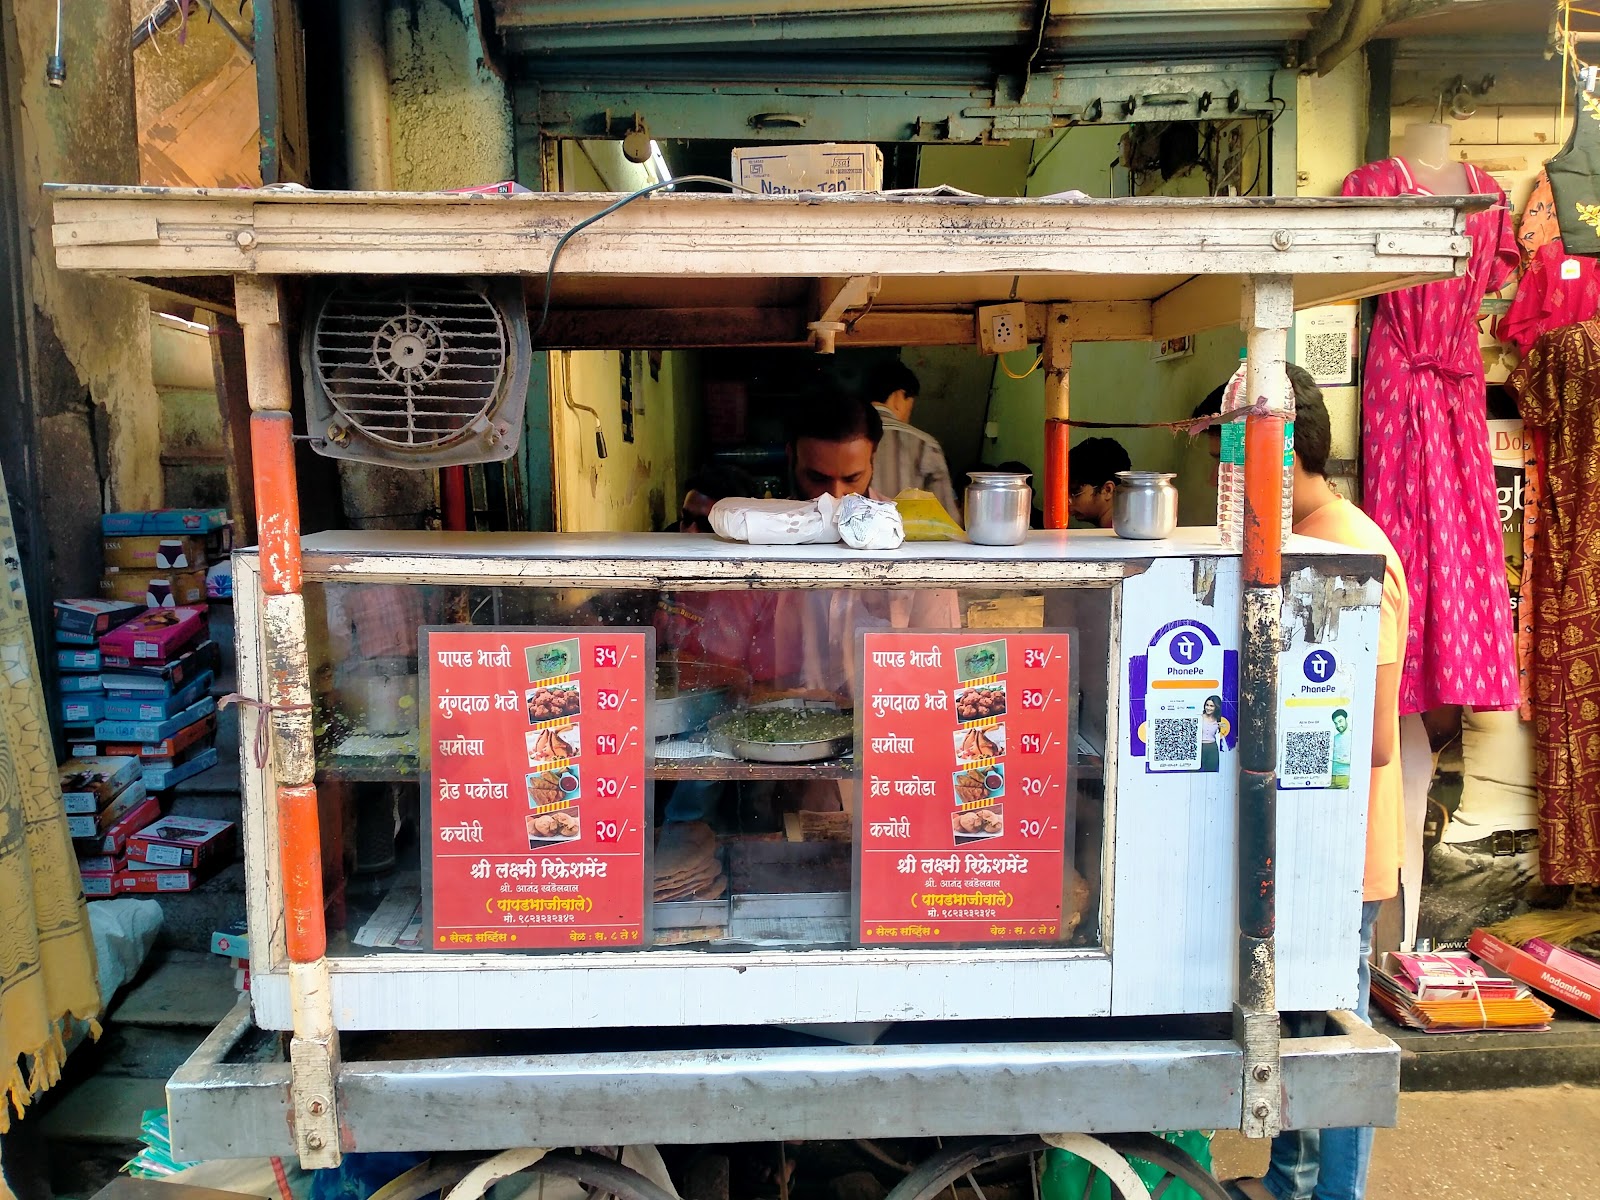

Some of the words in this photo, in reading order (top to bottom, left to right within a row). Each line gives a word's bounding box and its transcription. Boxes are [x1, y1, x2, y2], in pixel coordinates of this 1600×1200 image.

[761, 179, 812, 194] Natu
[438, 651, 472, 667] पापड
[477, 645, 512, 668] भाजी
[872, 651, 905, 668] पापड
[910, 646, 942, 668] भाजी
[1168, 666, 1204, 675] PhonePe
[1301, 685, 1336, 693] PhonePe
[438, 689, 490, 718] मुंगदाळ
[494, 690, 518, 712] भजे
[872, 689, 920, 718] मुंगदाळ
[925, 690, 948, 710] भजे
[439, 735, 484, 756] समोसा
[871, 732, 914, 754] समोसा
[440, 778, 460, 801] ब्रेड
[464, 778, 508, 800] पकोडा
[870, 776, 890, 798] ब्रेड
[894, 776, 936, 796] पकोडा
[440, 820, 484, 842] कचोरी
[870, 816, 910, 838] कचोरी
[470, 858, 492, 878] श्री
[495, 858, 537, 880] लक्ष्मी
[541, 857, 608, 880] रिफ्रेशमेंट
[896, 854, 917, 874] श्री
[921, 854, 960, 875] लक्ष्मी
[964, 853, 1028, 874] रिफ्रेशमेंट
[500, 882, 512, 892] श्री.
[516, 882, 539, 894] आनंद
[925, 878, 937, 888] श्री.
[940, 878, 962, 888] आनंद
[450, 932, 472, 944] सेल्फ
[620, 930, 628, 940] ते
[876, 926, 898, 936] सेल्फ
[1038, 925, 1046, 934] ते
[1541, 972, 1592, 1000] Madamform
